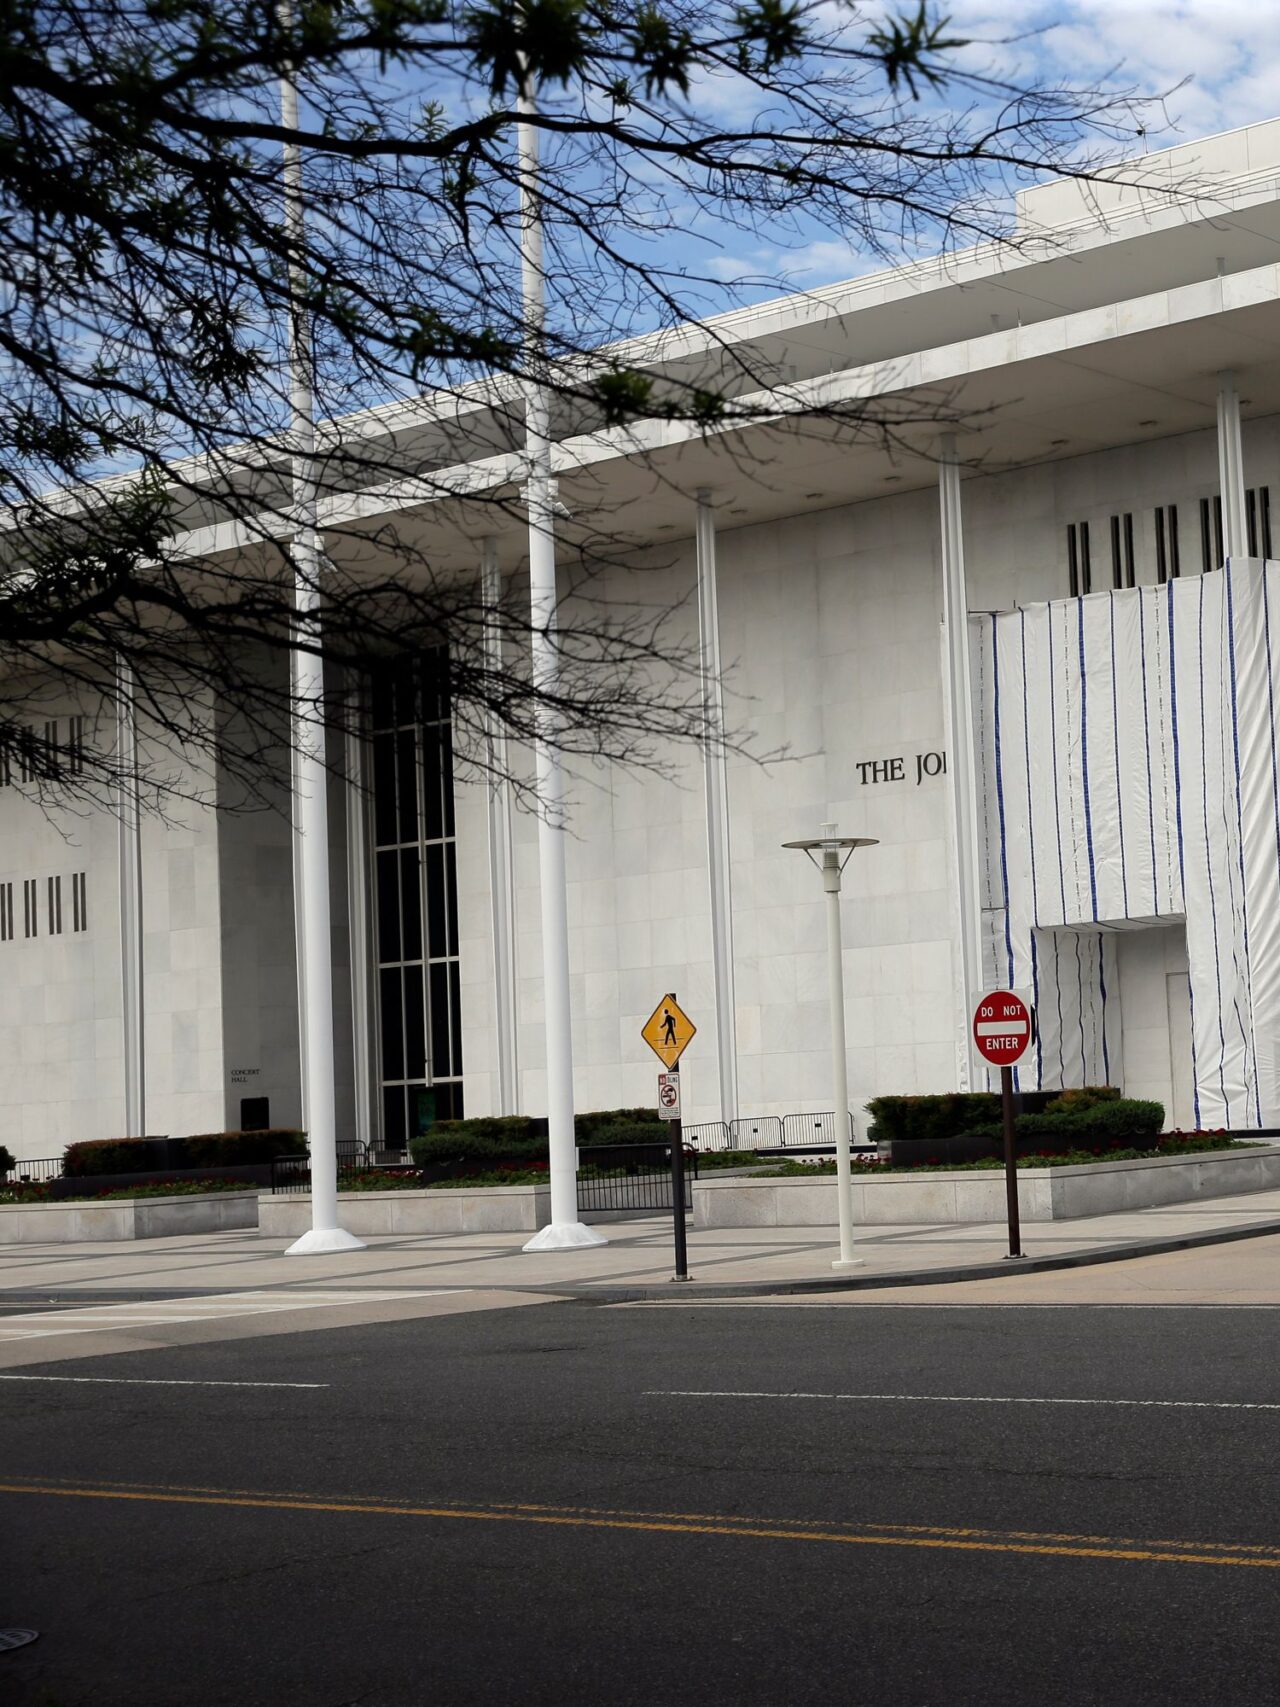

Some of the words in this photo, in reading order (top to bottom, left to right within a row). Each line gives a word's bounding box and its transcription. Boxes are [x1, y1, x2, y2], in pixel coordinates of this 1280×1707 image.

[856, 757, 905, 785] THE
[981, 1007, 993, 1017] DO
[1003, 1005, 1021, 1016] NOT
[986, 1037, 1019, 1050] ENTER
